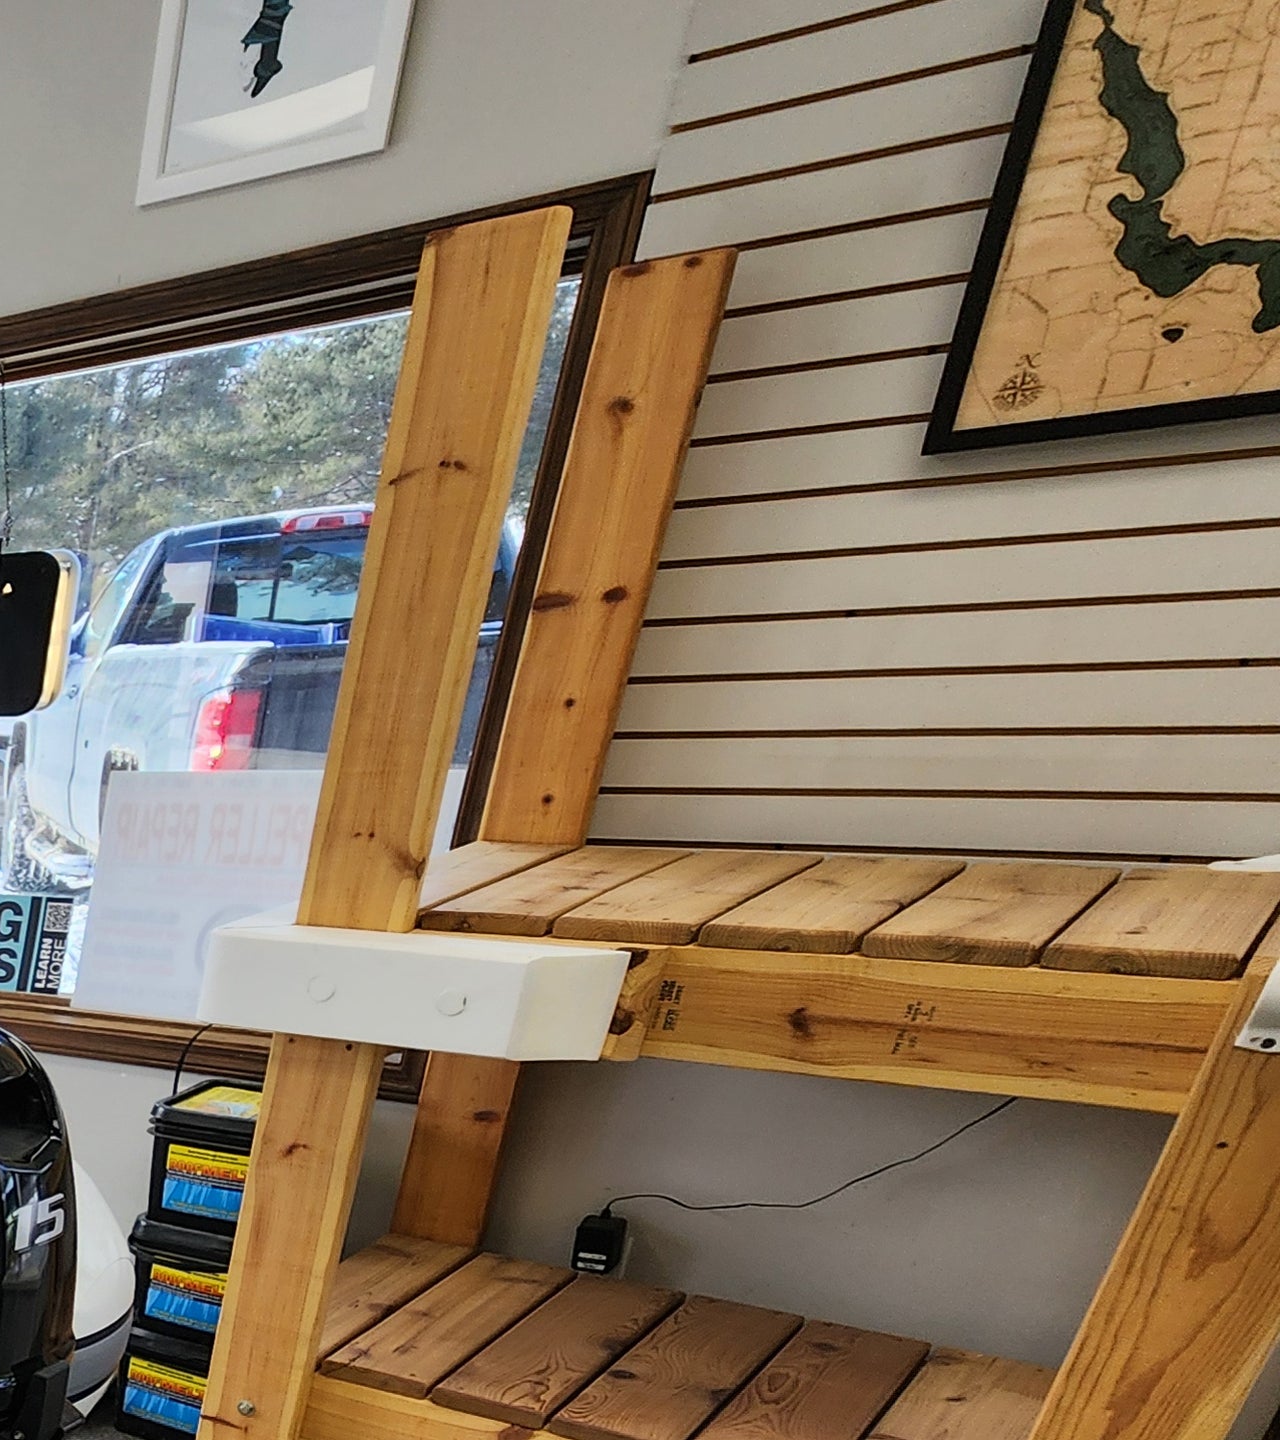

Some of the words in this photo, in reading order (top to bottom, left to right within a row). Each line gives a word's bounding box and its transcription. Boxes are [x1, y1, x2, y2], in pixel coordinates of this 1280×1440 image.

[34, 937, 54, 989] LEARN
[46, 938, 66, 990] MORE
[11, 1191, 65, 1252] 15
